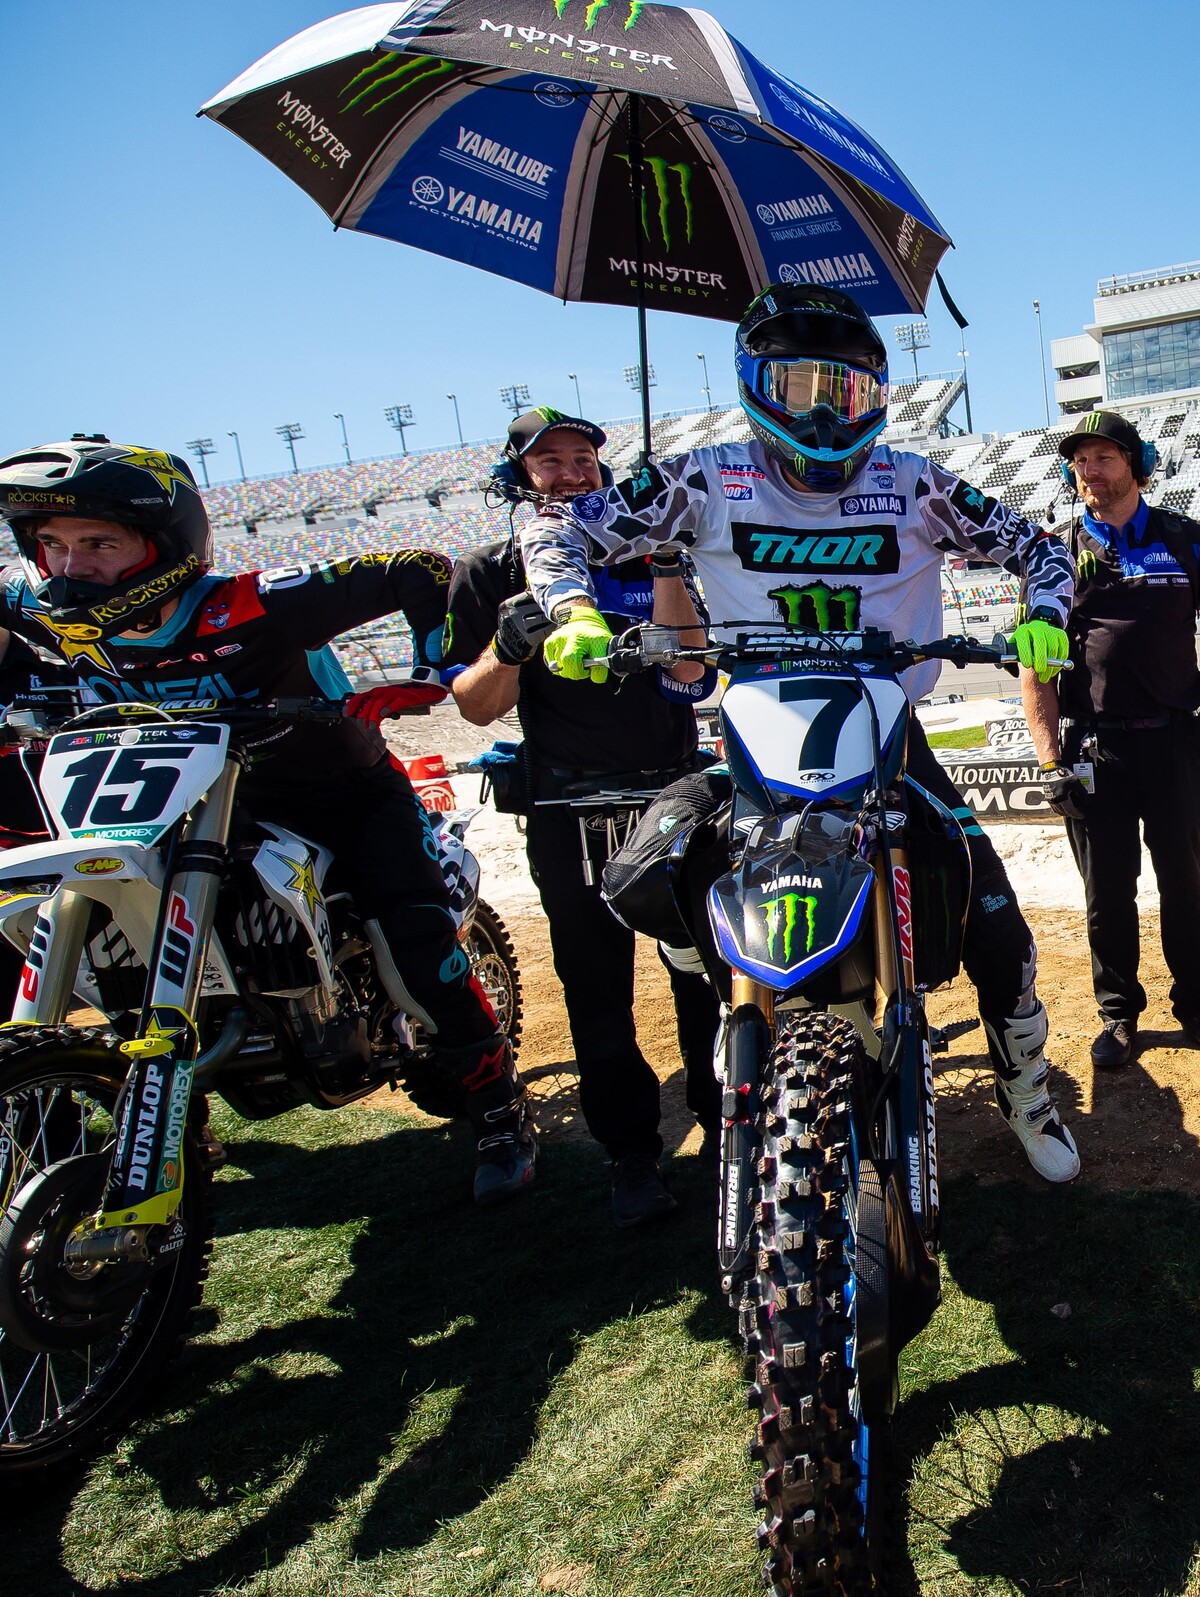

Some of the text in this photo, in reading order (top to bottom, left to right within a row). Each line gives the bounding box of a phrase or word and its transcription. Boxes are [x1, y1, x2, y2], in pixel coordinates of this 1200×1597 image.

[479, 18, 678, 71] MONSTER
[508, 41, 649, 74] ENERGY
[275, 121, 328, 171] ENERGY
[276, 90, 352, 169] MONSTER
[454, 126, 556, 187] YAMALUBE
[409, 200, 538, 251] FACTORY RACING
[447, 186, 544, 244] YAMAHA
[769, 193, 834, 221] YAMAHA
[770, 220, 842, 242] FINANCIAL SERVICES
[630, 279, 711, 298] ENERGY
[795, 252, 876, 283] YAMAHA
[839, 279, 880, 289] RACING
[750, 533, 884, 566] THOR
[246, 725, 293, 748] SCOSCHE
[778, 678, 863, 771] 7
[59, 747, 196, 829] 15
[94, 828, 155, 840] MOTOREX
[77, 858, 124, 874] FMF
[760, 874, 823, 895] YAMAHA
[159, 892, 195, 990] WP
[128, 1063, 164, 1191] DUNLOP
[163, 1065, 193, 1158] MOTOREX
[923, 1036, 941, 1212] DUNLOP
[907, 1135, 922, 1213] BRAKING
[726, 1165, 739, 1248] BRAKING
